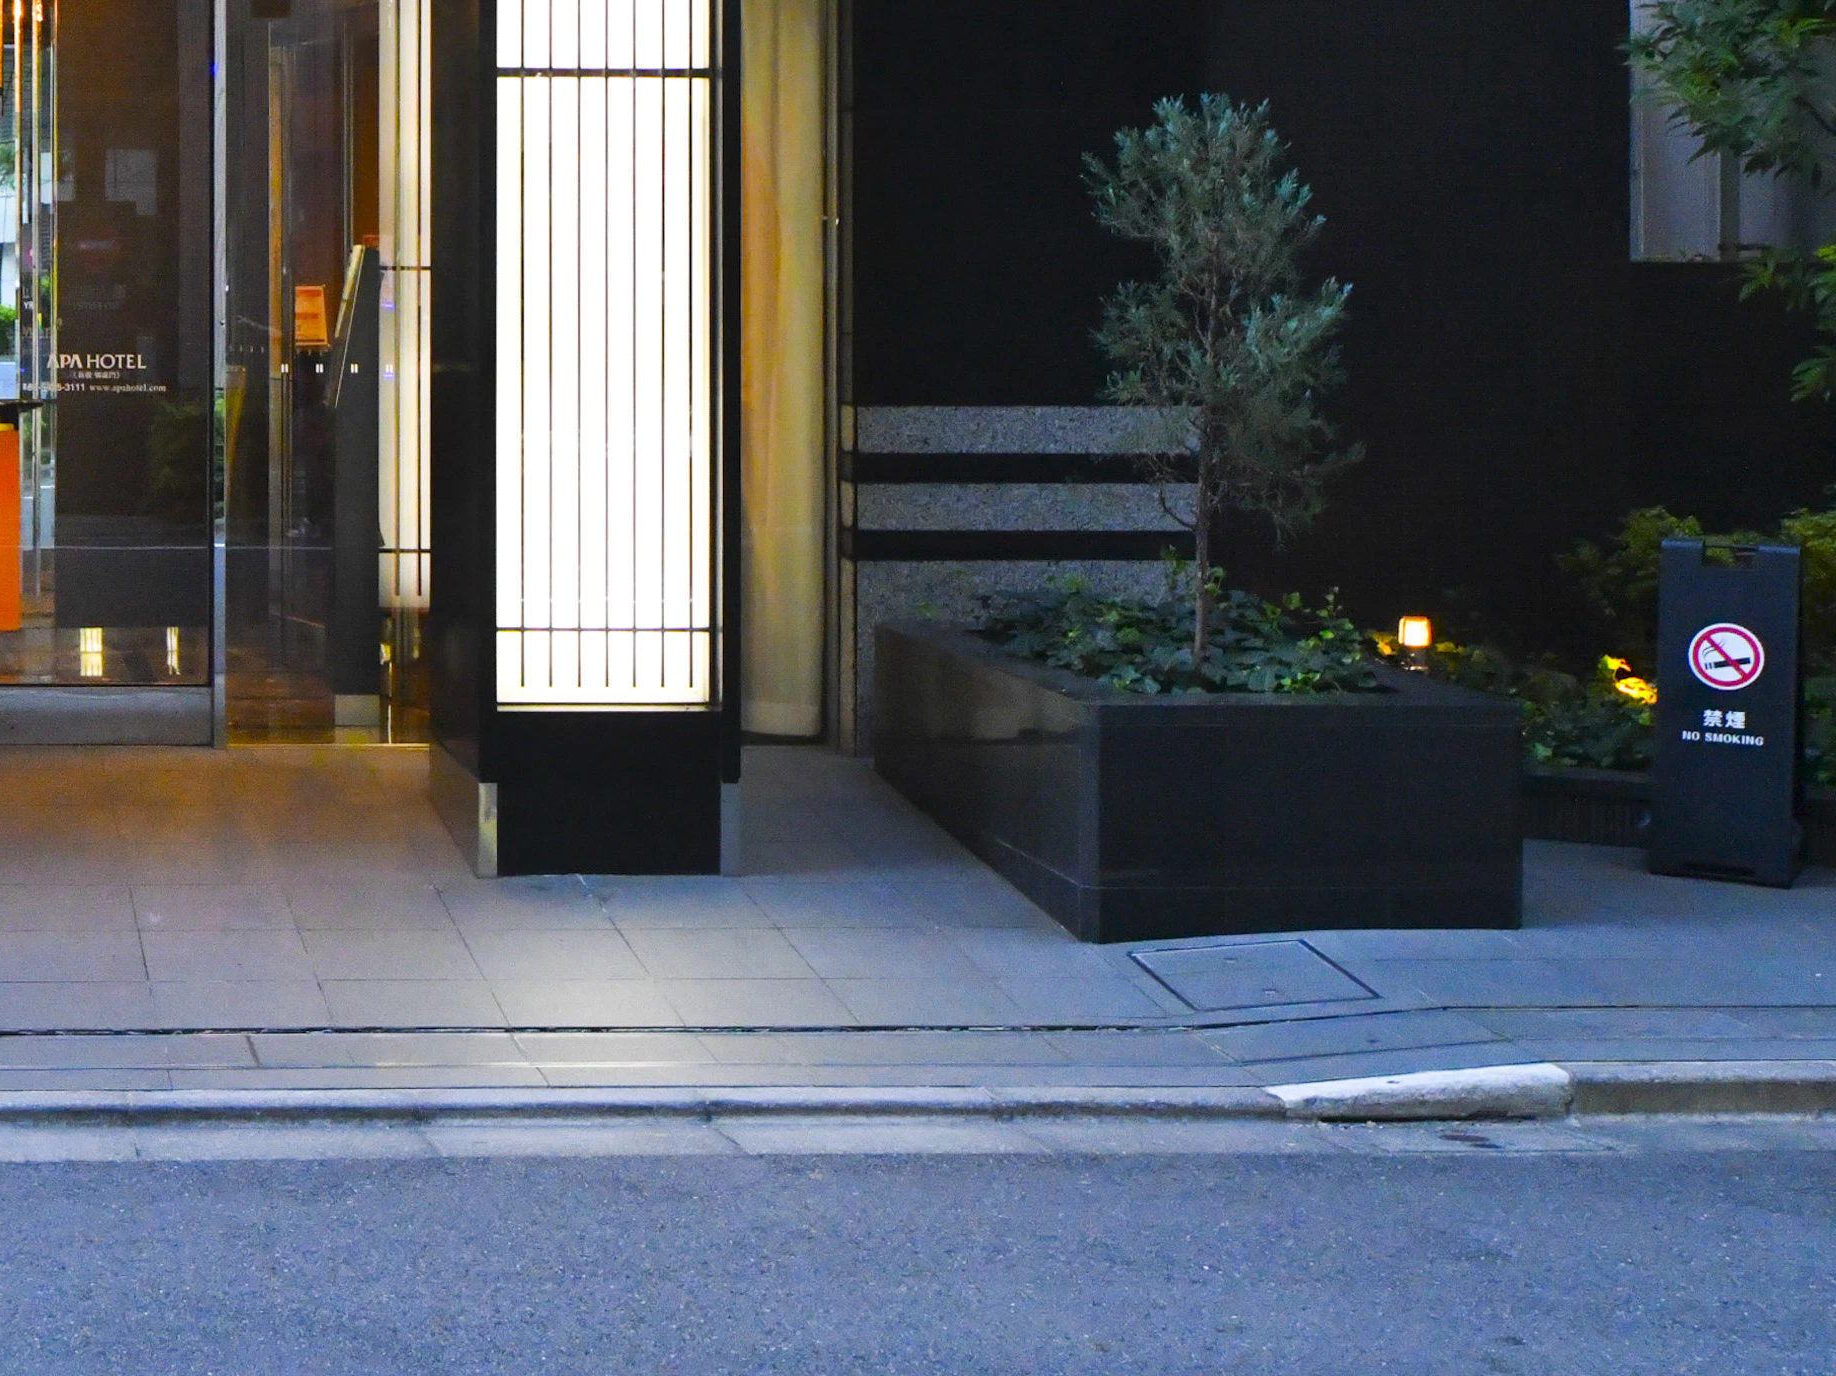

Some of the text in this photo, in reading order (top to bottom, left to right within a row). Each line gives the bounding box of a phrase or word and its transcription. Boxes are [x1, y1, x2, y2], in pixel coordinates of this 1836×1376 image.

[46, 353, 148, 369] APA HOTEL
[1703, 709, 1746, 729] 禁煙
[1682, 730, 1764, 746] NO SMOKING
